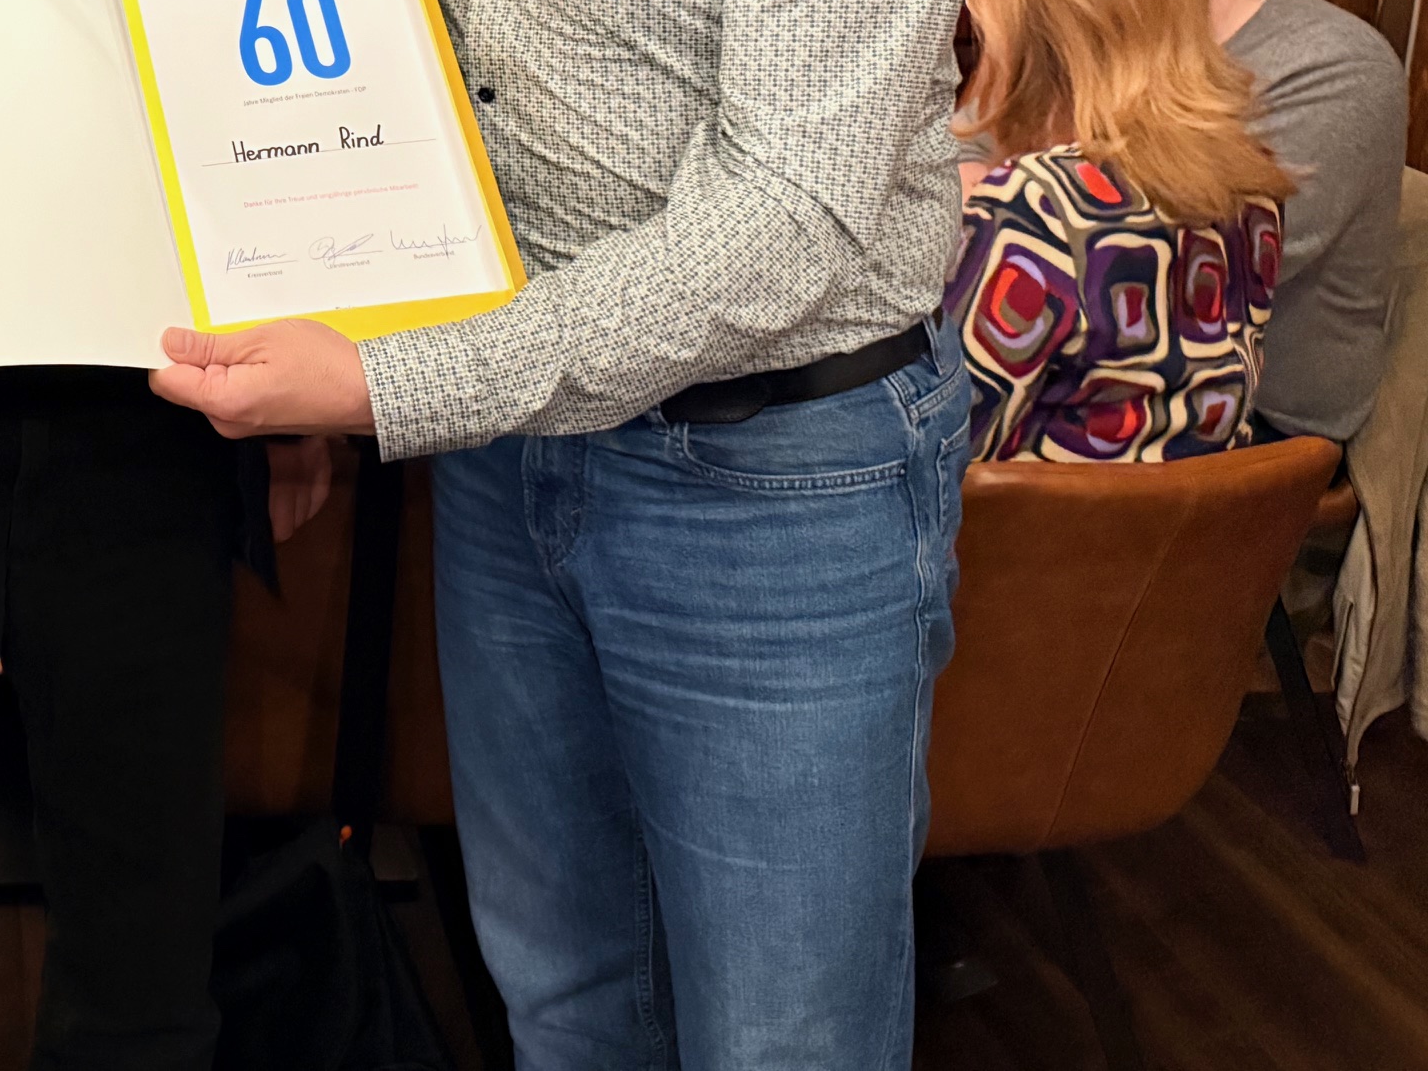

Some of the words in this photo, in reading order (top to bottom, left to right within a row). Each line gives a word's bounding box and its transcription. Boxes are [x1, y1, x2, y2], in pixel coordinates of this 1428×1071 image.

[284, 94, 294, 102] der
[314, 88, 350, 98] Demokraten
[231, 140, 320, 164] Hermann
[339, 124, 384, 150] Rind
